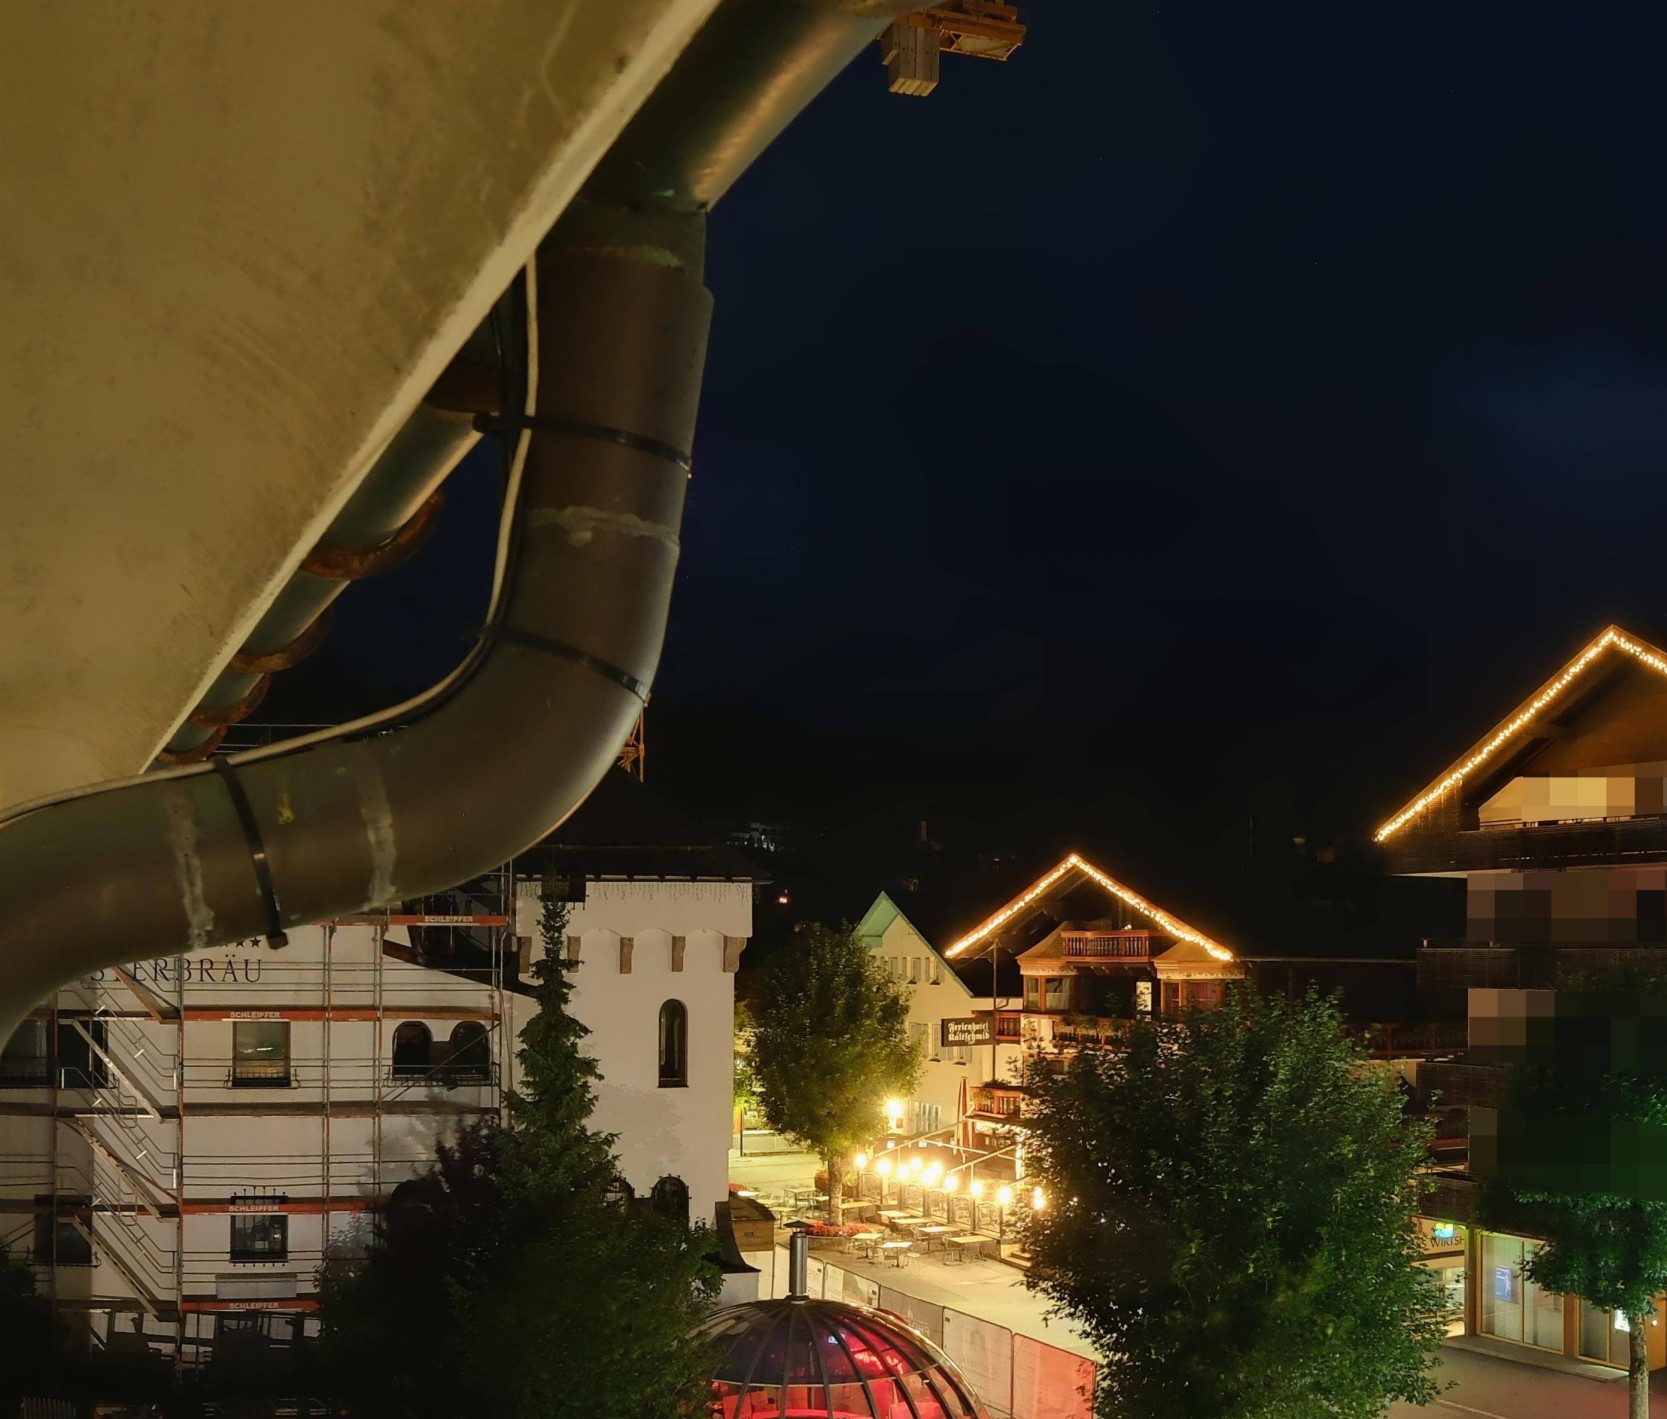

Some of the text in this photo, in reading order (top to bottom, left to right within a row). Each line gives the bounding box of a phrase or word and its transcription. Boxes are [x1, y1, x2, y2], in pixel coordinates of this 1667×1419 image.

[424, 915, 474, 923] SCHLEIPFER
[229, 1010, 281, 1019] SCHLEIPFER
[228, 1204, 280, 1213] SCHLEIPFER
[228, 1301, 280, 1310] SCHLEIPFER
